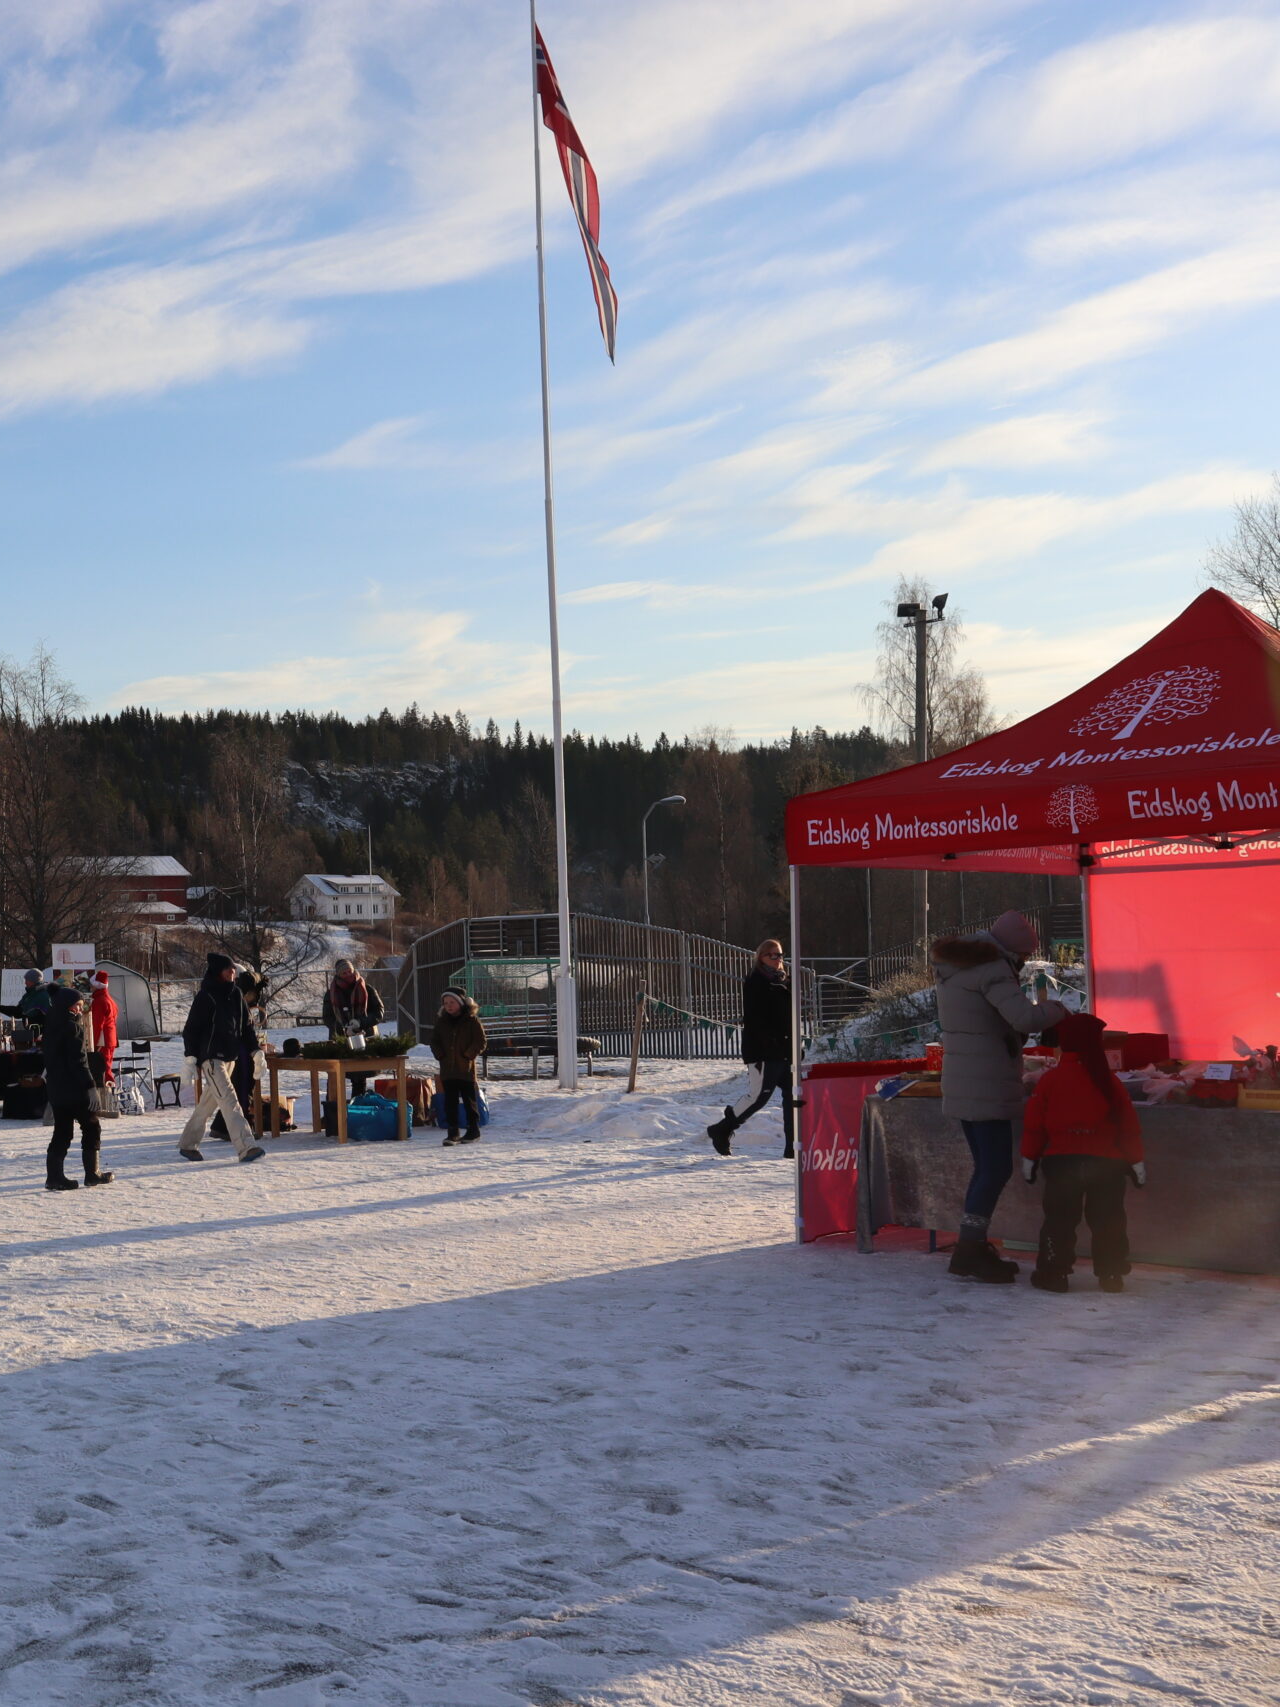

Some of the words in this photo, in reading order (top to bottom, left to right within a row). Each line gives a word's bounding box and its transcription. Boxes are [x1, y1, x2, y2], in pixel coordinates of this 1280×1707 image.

[938, 757, 1045, 779] Eidskog
[1047, 727, 1280, 769] Montessoriskole
[1127, 787, 1213, 822] Eidskog
[1216, 779, 1278, 812] Mont
[806, 817, 870, 850] Eidskog
[874, 802, 1019, 841] Montessoriskole
